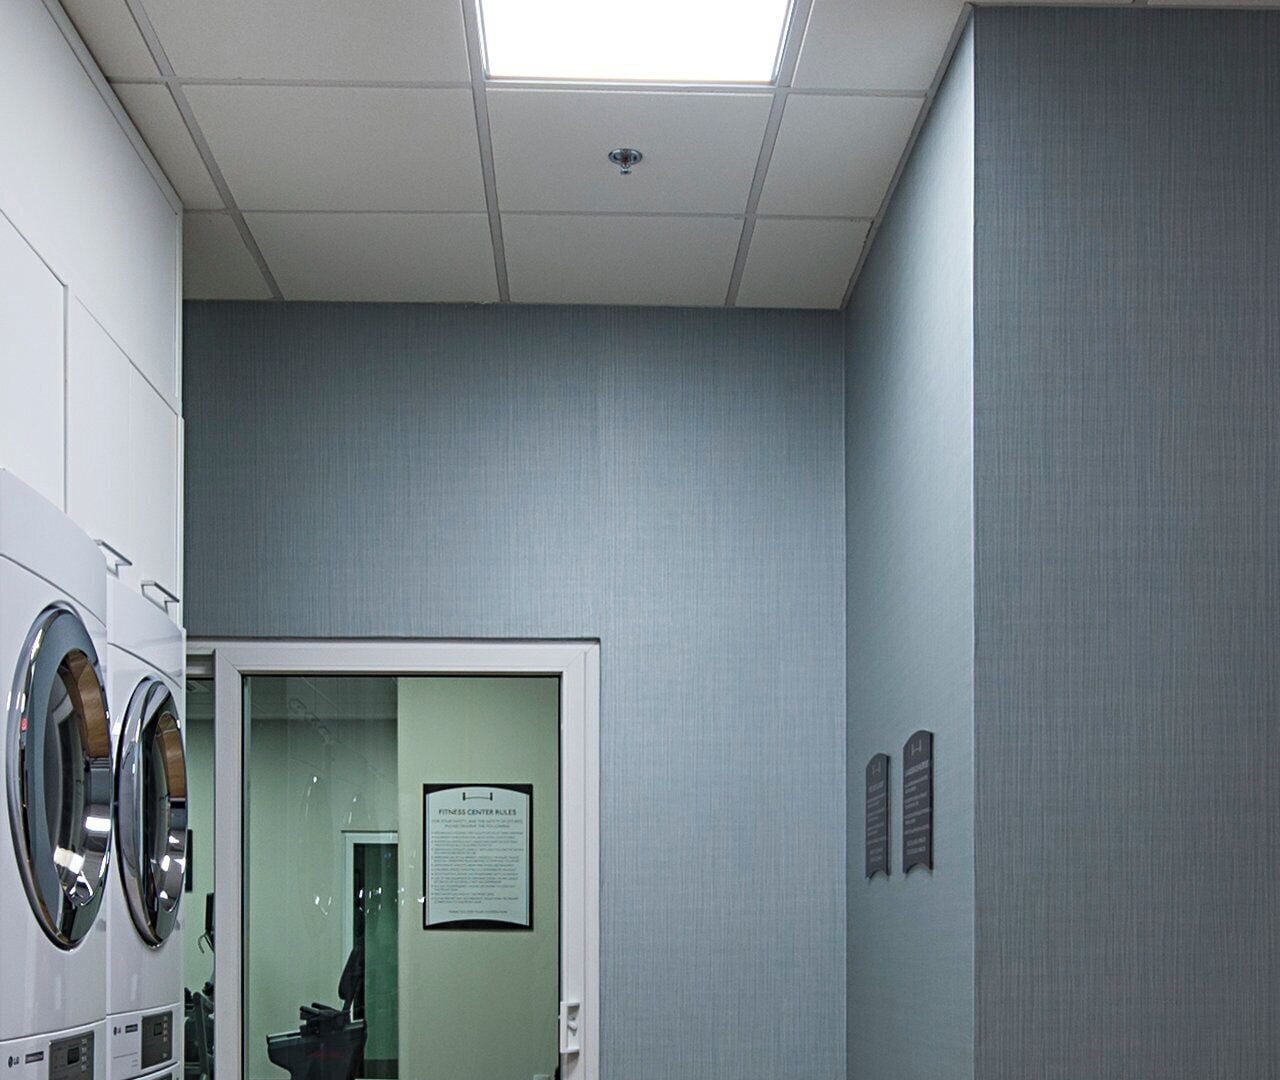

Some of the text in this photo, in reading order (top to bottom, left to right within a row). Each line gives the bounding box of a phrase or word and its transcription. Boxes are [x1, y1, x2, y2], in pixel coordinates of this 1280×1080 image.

[438, 808, 517, 816] FITNESS CENTER RULES
